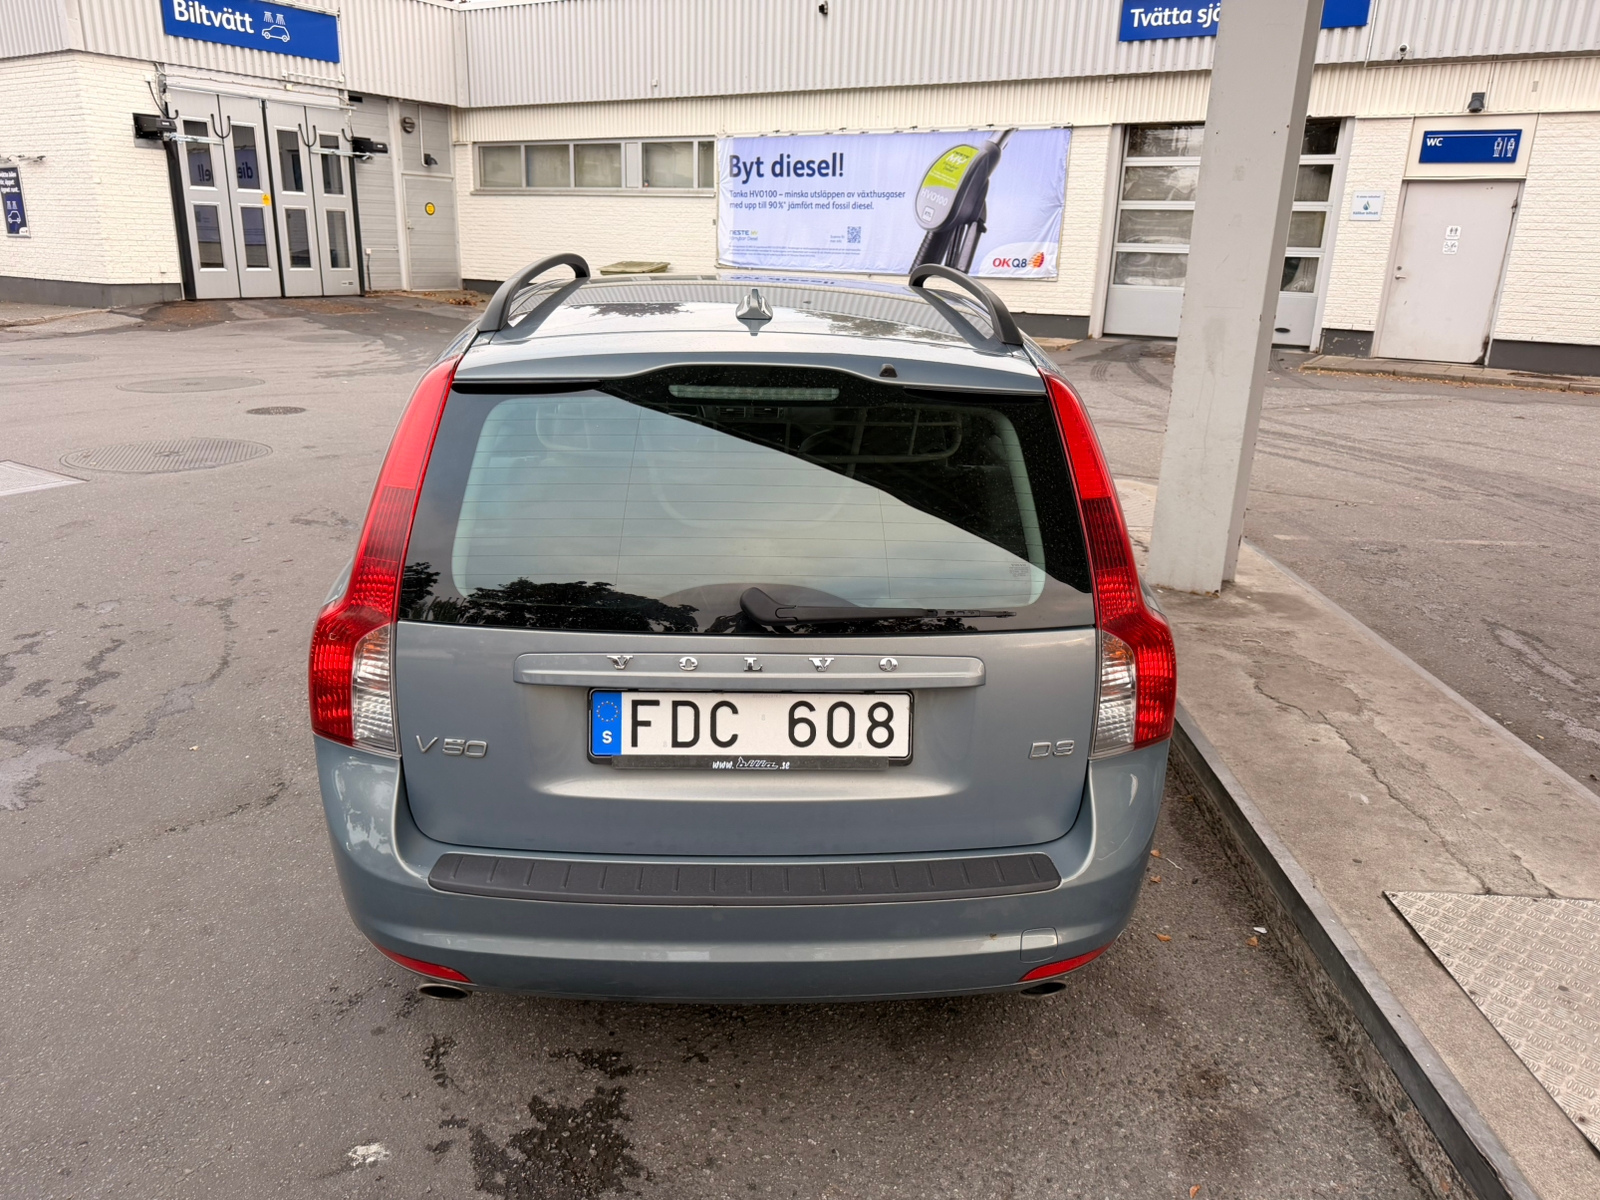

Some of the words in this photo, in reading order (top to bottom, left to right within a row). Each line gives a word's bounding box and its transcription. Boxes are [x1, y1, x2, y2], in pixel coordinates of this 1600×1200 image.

[173, 0, 255, 34] Biltvätt
[1130, 7, 1192, 28] Tvätta
[1426, 137, 1443, 147] WC
[729, 154, 765, 185] Byt
[771, 152, 844, 178] diesel!
[729, 190, 748, 198] Tanka
[750, 190, 778, 198] HVO100
[785, 190, 808, 198] minska
[810, 190, 845, 200] utsläppen
[857, 190, 906, 200] växthusgaser
[920, 187, 948, 207] HVO100
[729, 201, 743, 209] med
[744, 202, 757, 211] upp
[758, 201, 767, 209] till
[787, 201, 813, 211] jämfört
[815, 201, 830, 210] med
[832, 201, 850, 210] fossil
[852, 201, 874, 210] diesel.
[992, 257, 1028, 268] OKQ8
[606, 655, 899, 674] VOLVO
[631, 699, 739, 748] FDC
[788, 700, 895, 749] 608
[415, 735, 488, 758] V50
[602, 730, 613, 744] S
[1028, 739, 1075, 759] D3
